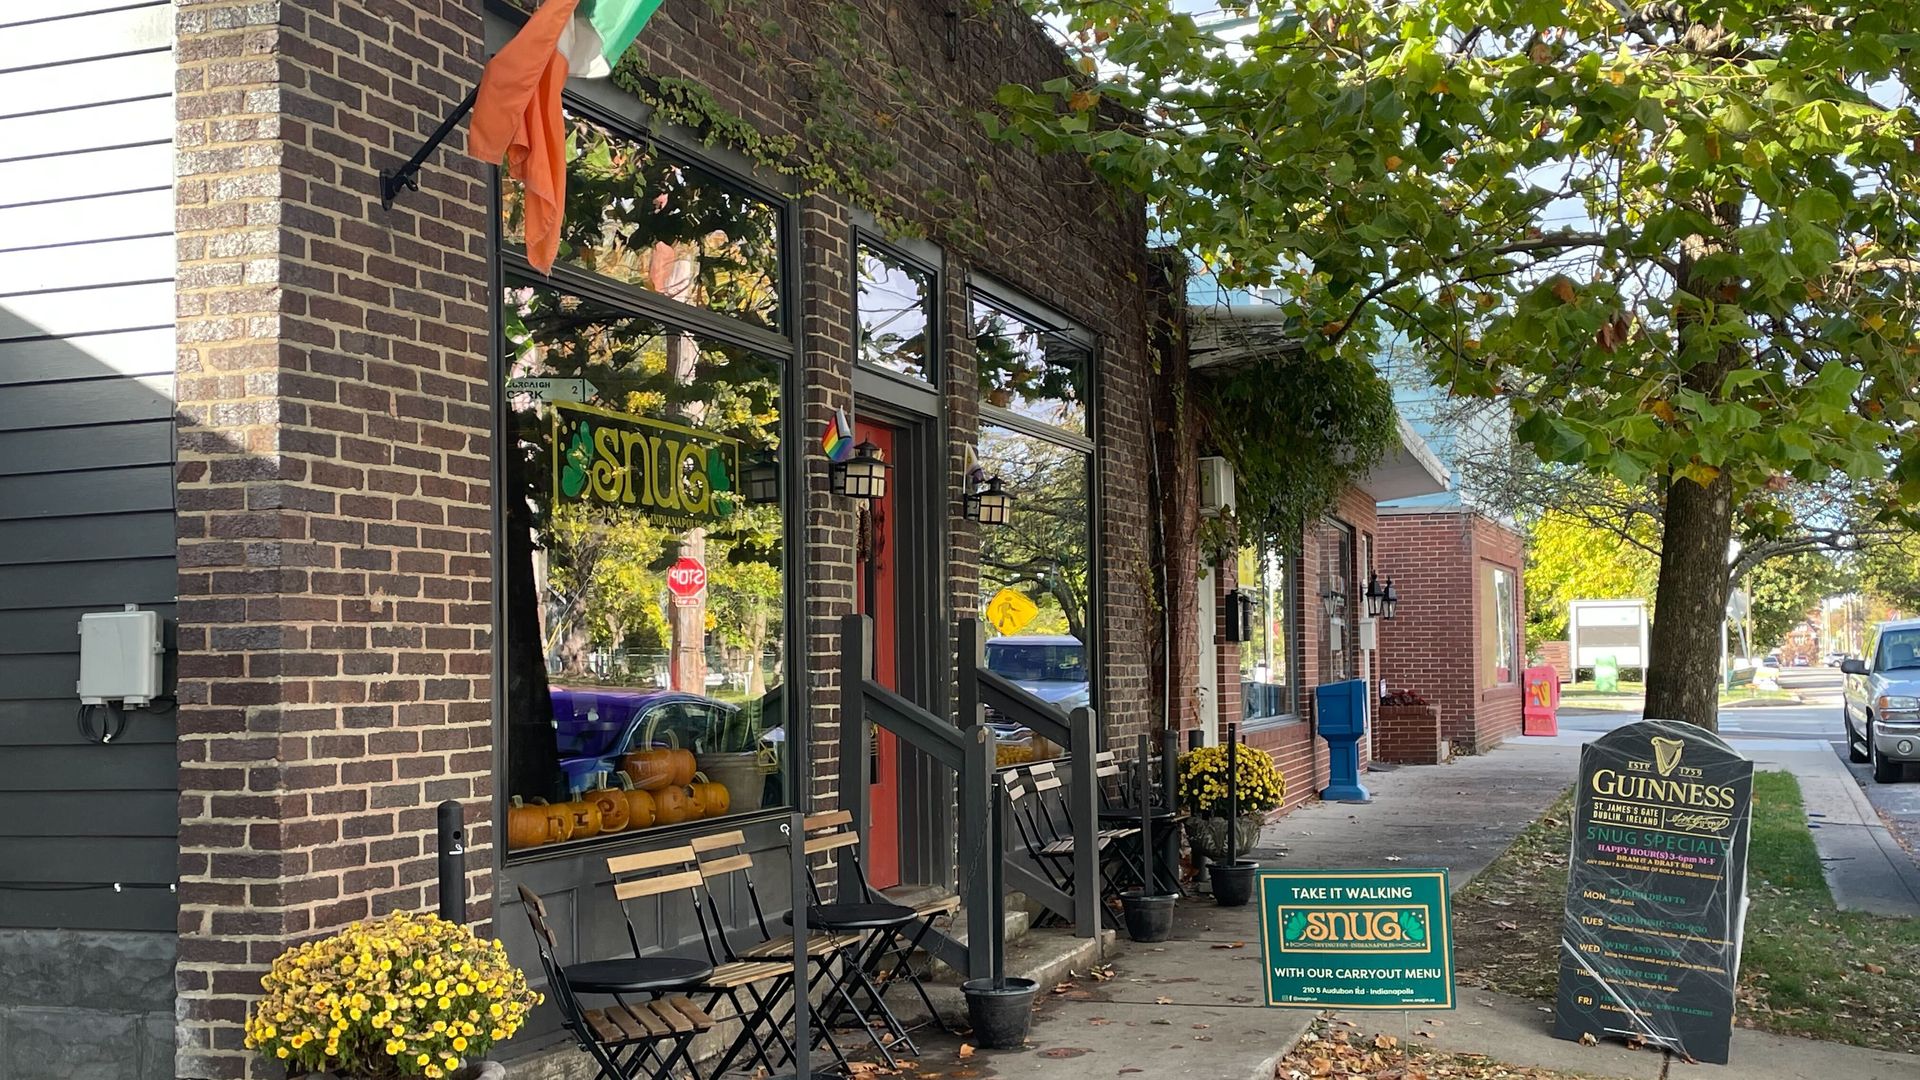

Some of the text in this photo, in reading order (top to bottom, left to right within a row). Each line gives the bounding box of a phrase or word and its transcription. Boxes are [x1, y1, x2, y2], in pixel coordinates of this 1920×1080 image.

[571, 385, 579, 395] 2
[1679, 767, 1703, 777] 1759
[1591, 769, 1736, 810] GUINNESS
[1593, 802, 1659, 817] ST. JAMES'S GATE
[1626, 814, 1659, 826] IRELAND
[1586, 826, 1730, 857] SNUG SPECIALS
[1597, 843, 1630, 854] HAPPY
[1630, 848, 1669, 860] HOUR(S)
[1669, 853, 1698, 864] 3-6pm
[1598, 860, 1615, 868] DRAFT
[1625, 864, 1650, 872] MEASURE
[1616, 854, 1640, 863] DRAM
[1653, 859, 1681, 868] DRAFT
[1291, 886, 1413, 900] TAKE IT WALKING
[1583, 890, 1607, 901] MON
[1305, 911, 1403, 941] SNUG
[1581, 916, 1604, 926] TUES
[1579, 943, 1601, 953] WED
[1631, 945, 1652, 954] AND
[1274, 967, 1442, 980] WITH OUR CARRYOUT MENU
[1302, 986, 1316, 994] 210
[1322, 987, 1354, 995] Audubon
[1354, 986, 1365, 995] Rd
[1370, 988, 1415, 997] Indianapolis
[1578, 995, 1593, 1006] FRI
